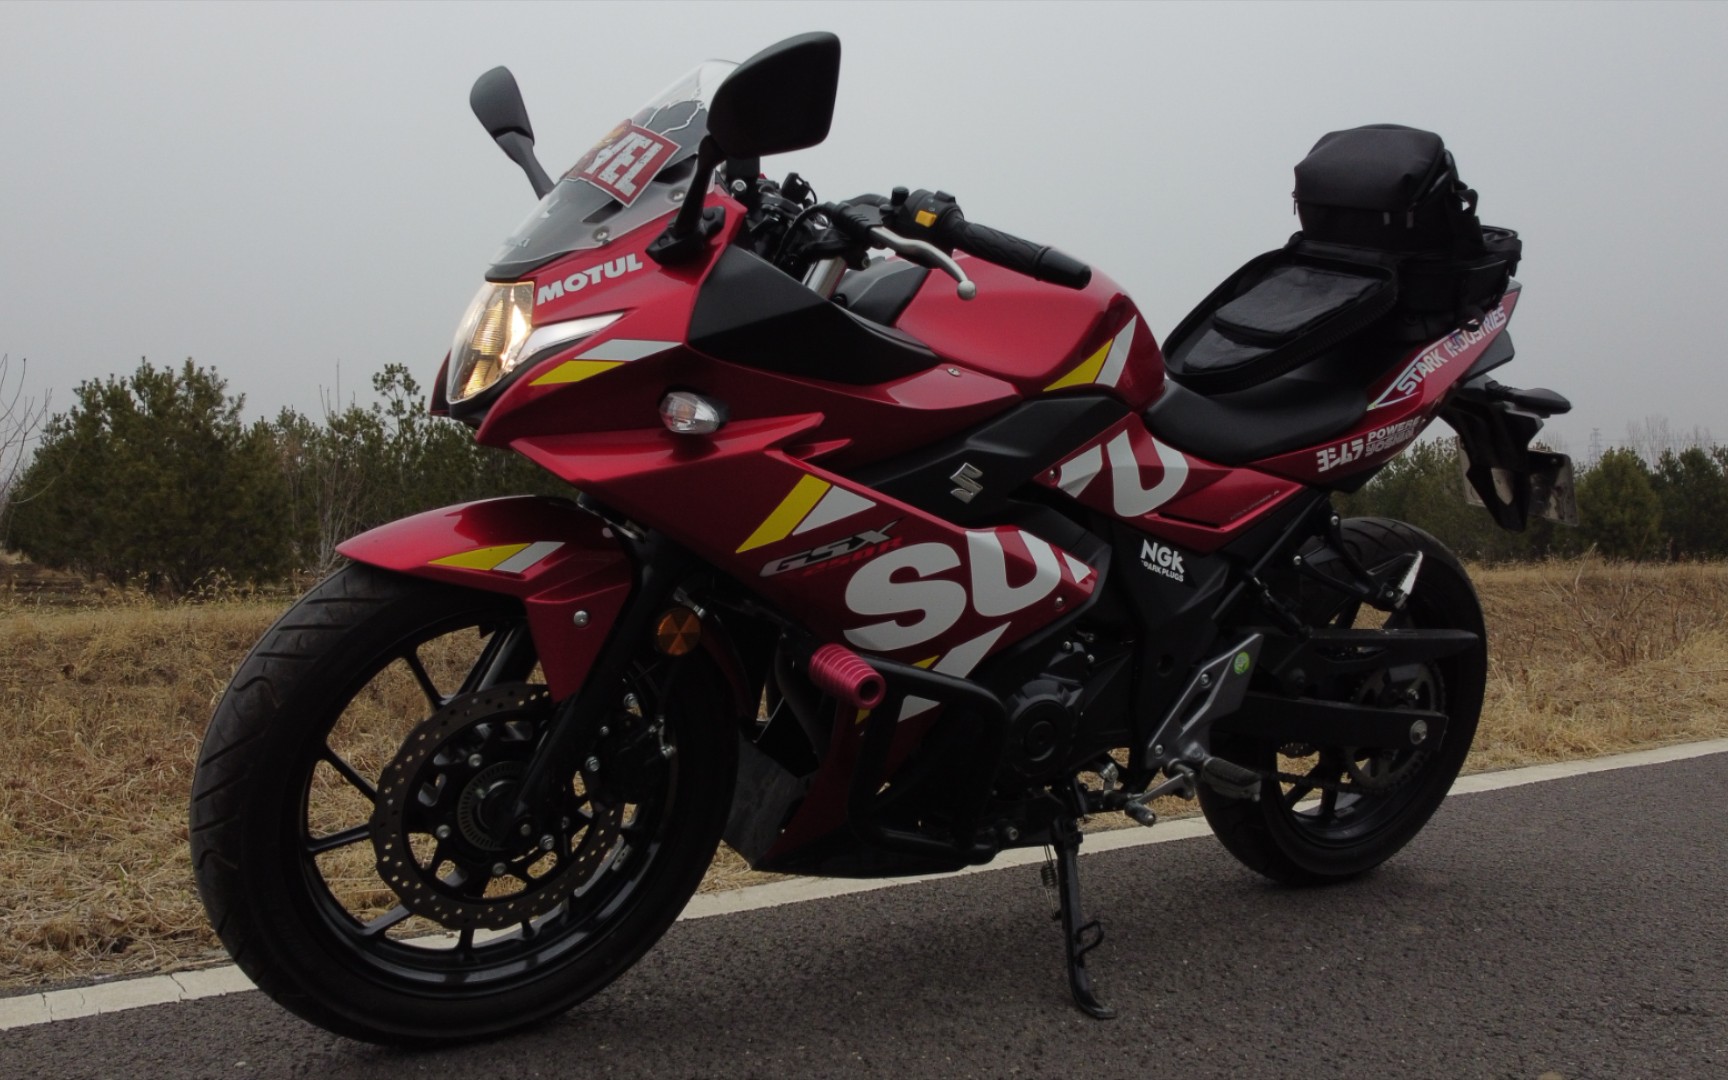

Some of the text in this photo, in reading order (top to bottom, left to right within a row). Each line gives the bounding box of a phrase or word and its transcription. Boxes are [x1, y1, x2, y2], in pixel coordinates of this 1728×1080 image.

[536, 253, 643, 305] MOTUL
[1397, 349, 1448, 395] STARK
[759, 517, 902, 577] GSX
[1140, 538, 1184, 574] NGK
[1141, 560, 1184, 583] PARK PLUGS
[843, 530, 1091, 651] SU
